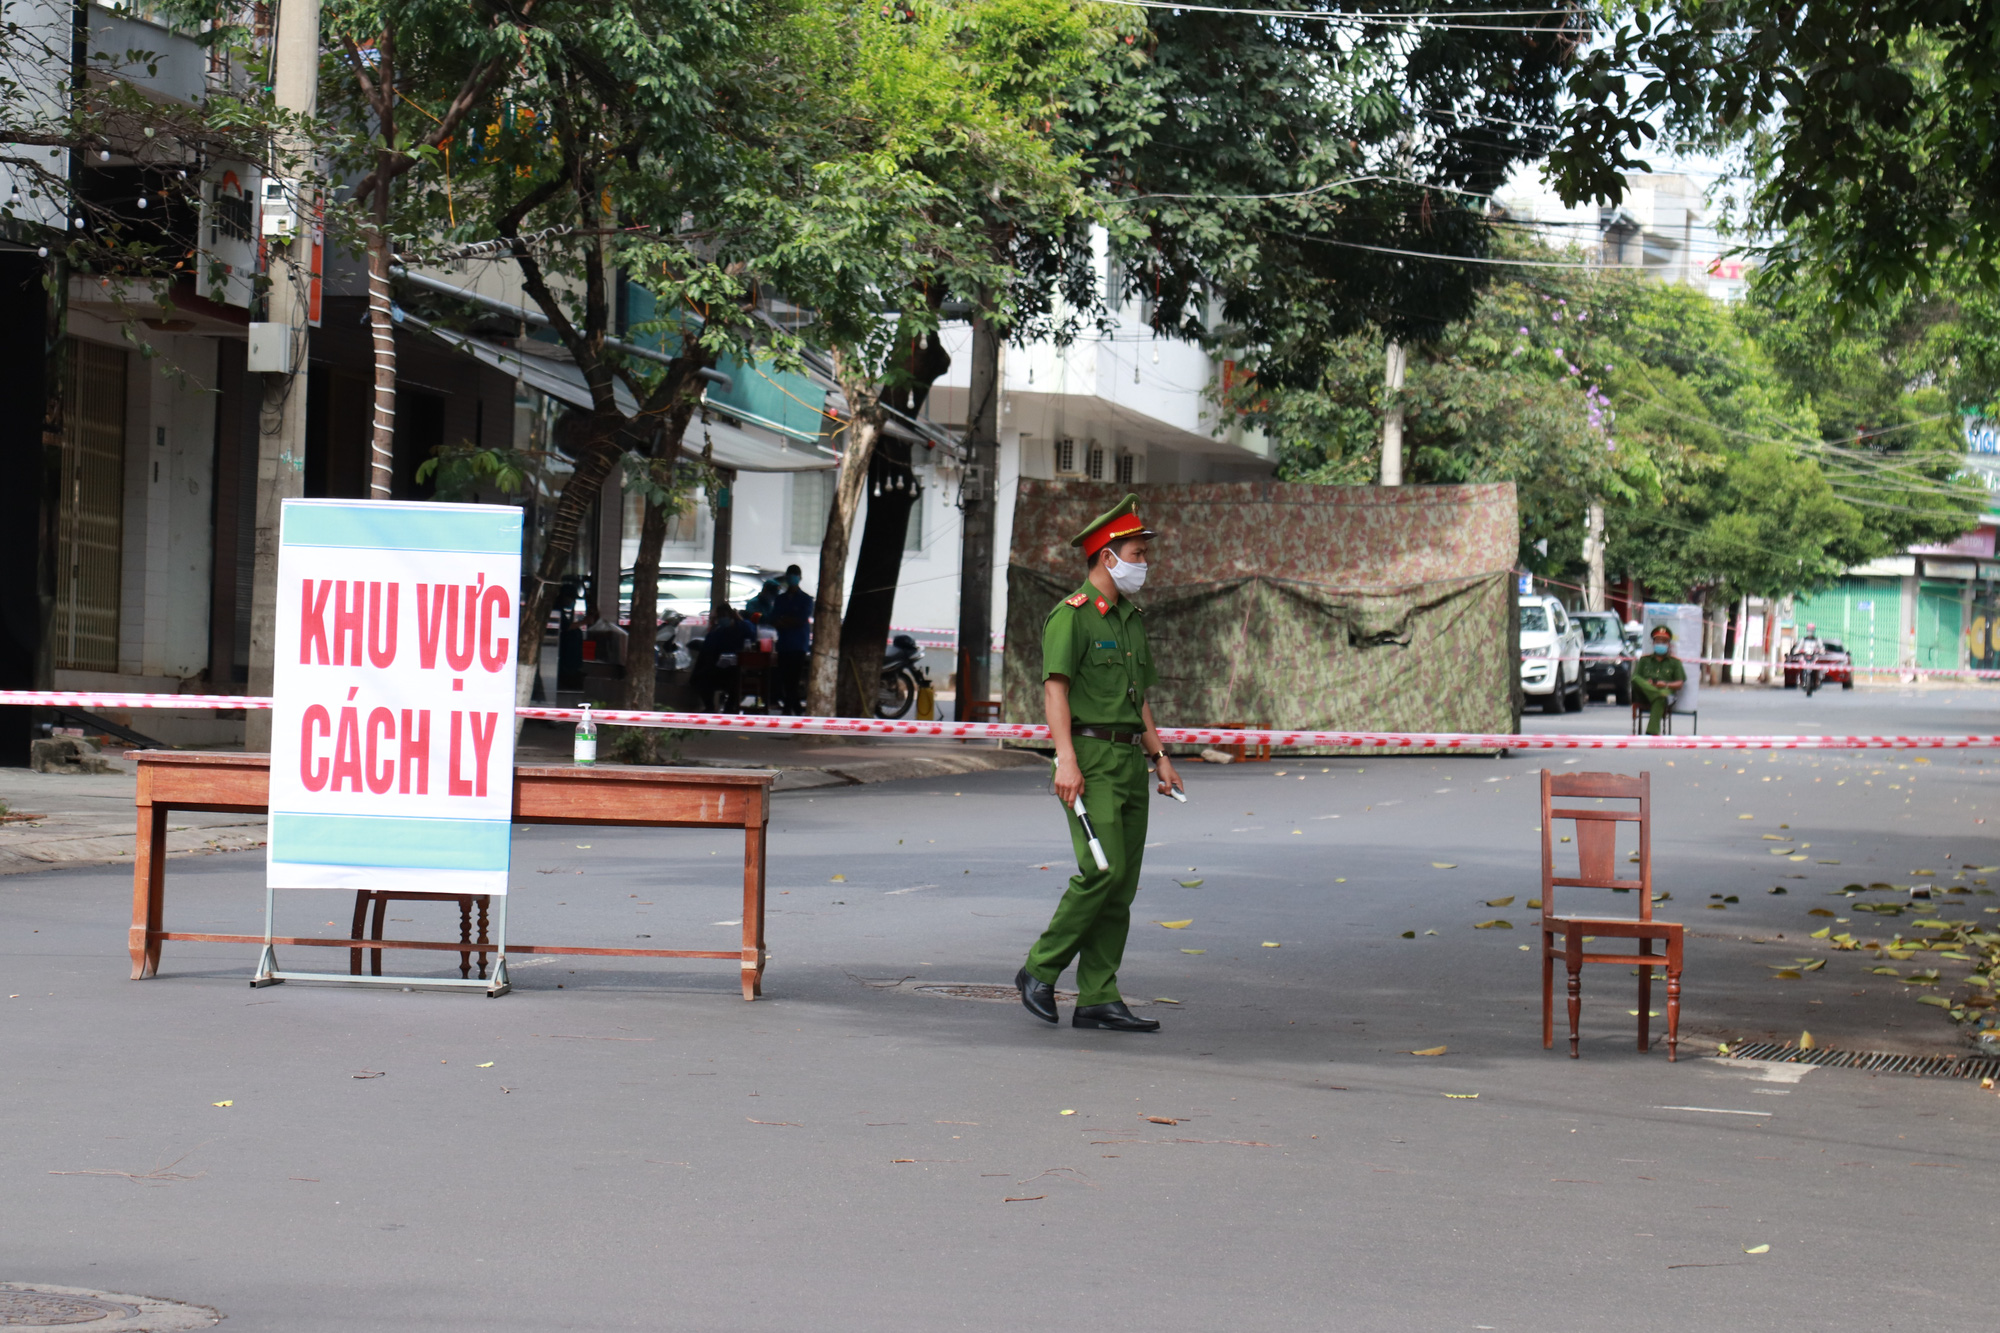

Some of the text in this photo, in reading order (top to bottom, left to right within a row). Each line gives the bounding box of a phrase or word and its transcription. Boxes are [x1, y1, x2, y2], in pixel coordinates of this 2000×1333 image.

[300, 572, 511, 692] KHU VỰC
[300, 686, 499, 797] CÁCH LY
